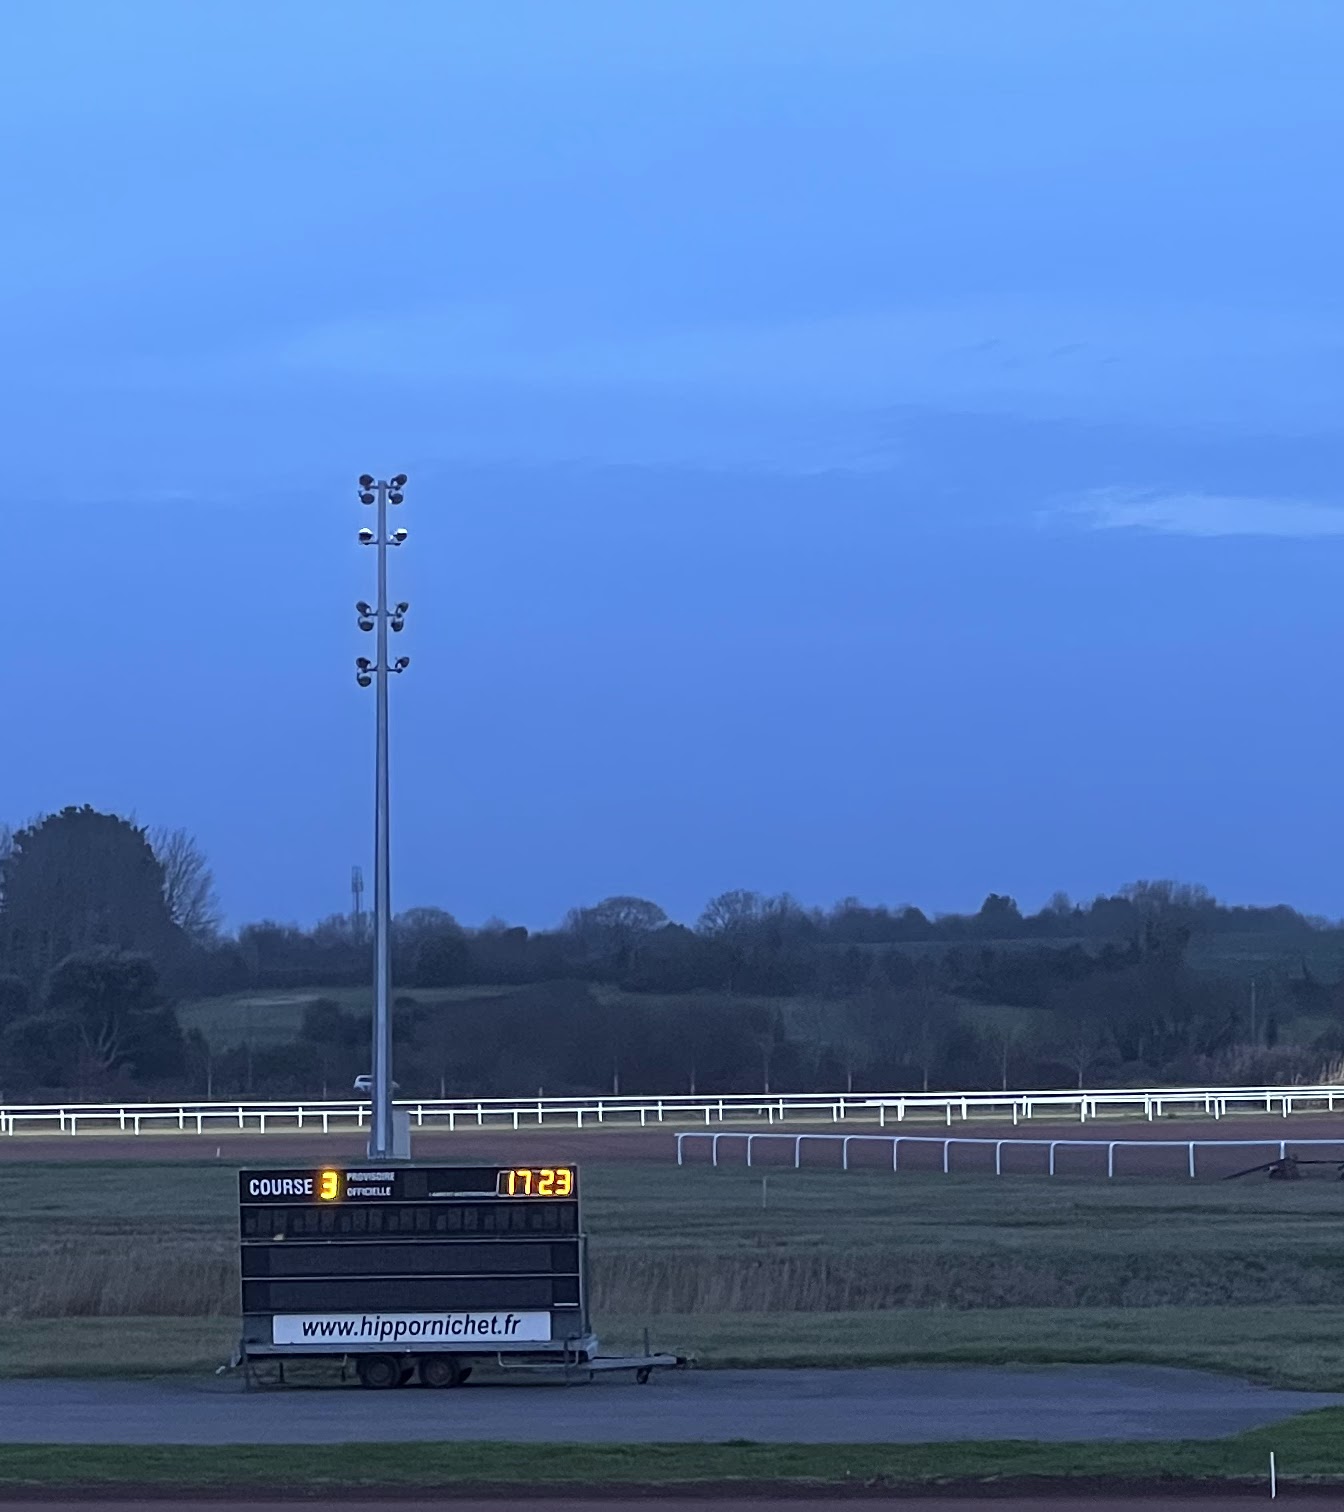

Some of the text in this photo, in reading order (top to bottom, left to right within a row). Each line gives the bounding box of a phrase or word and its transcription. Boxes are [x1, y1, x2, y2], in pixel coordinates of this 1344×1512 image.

[249, 1171, 339, 1200] COURSE 3
[347, 1172, 395, 1182] PROVISOIRE
[347, 1187, 391, 1196] OFFICIELLE
[302, 1314, 521, 1341] www.hippornichet.fr
